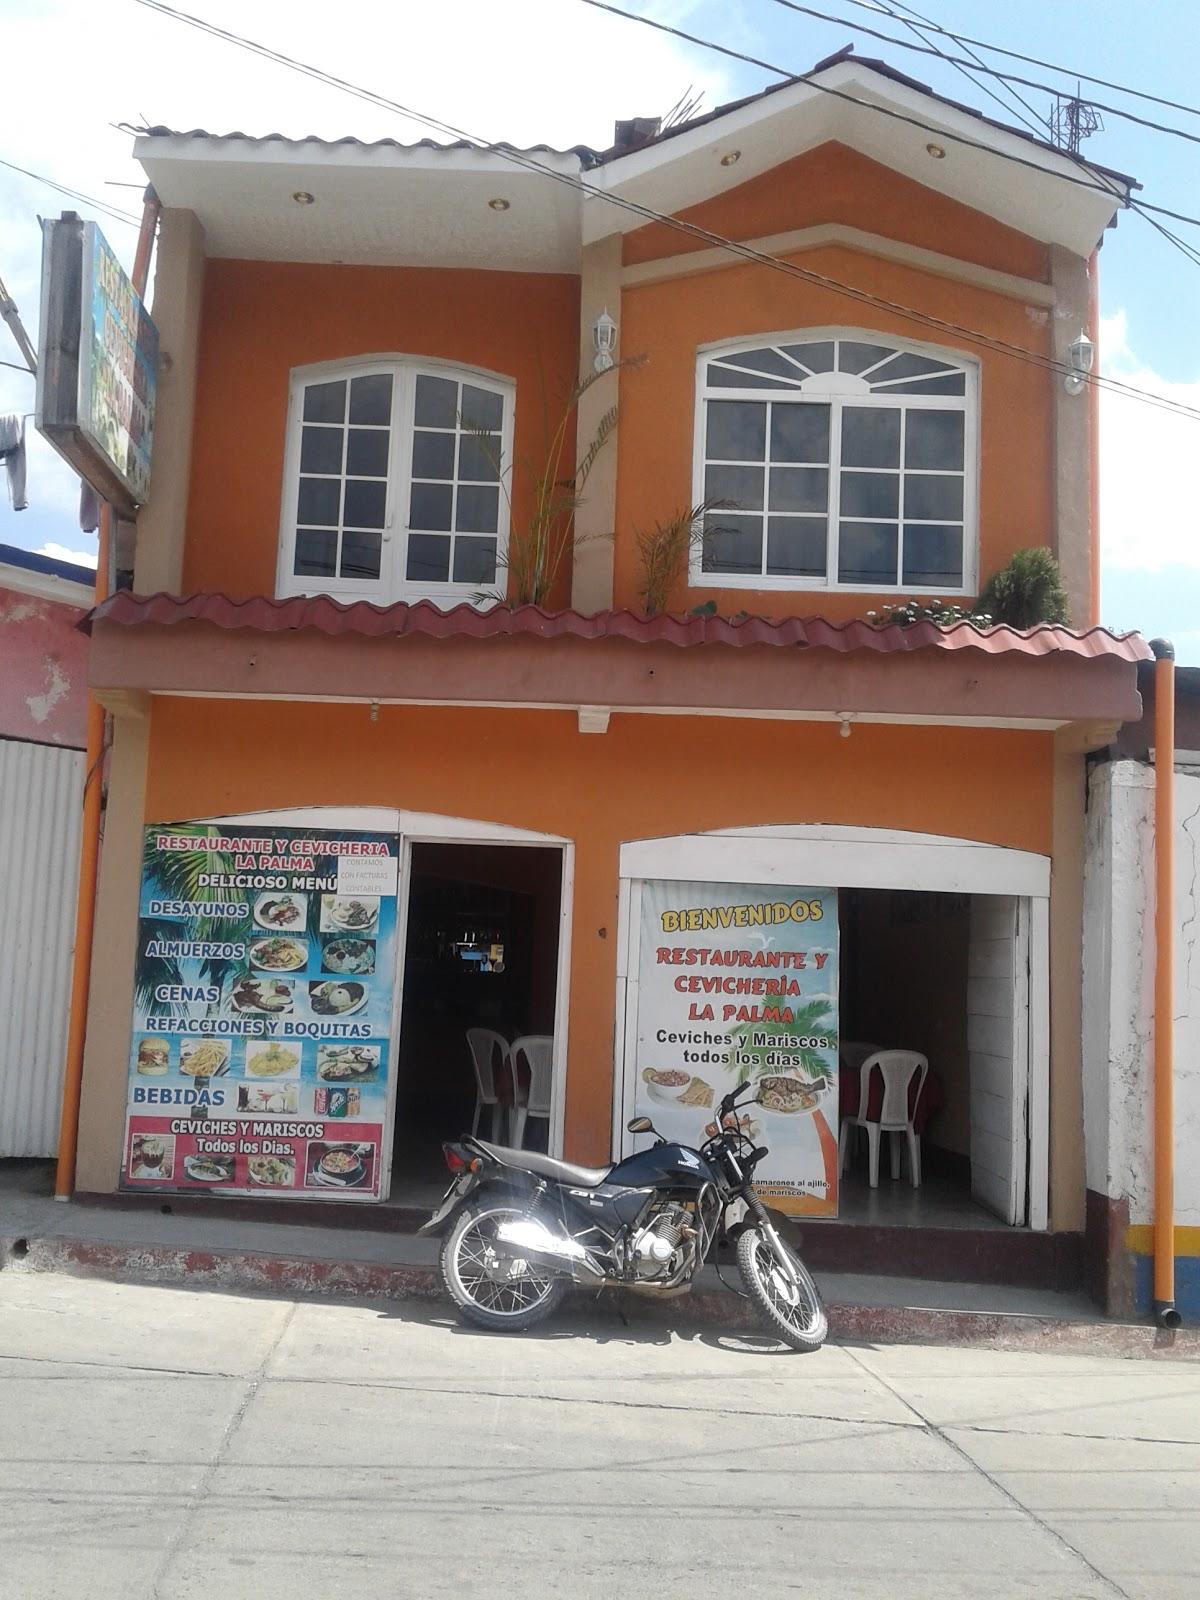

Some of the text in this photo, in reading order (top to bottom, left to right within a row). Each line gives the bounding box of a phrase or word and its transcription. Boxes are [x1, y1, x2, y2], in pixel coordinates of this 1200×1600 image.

[157, 836, 389, 856] RESTAURANTE Y CEVICHERIA
[234, 855, 315, 871] LA PALMA
[198, 873, 338, 890] DELICIOSO MENÚ
[341, 871, 388, 880] CON FACTURAS
[150, 900, 248, 917] DESAYUNOS
[661, 900, 823, 932] BIENVENIDOS
[145, 941, 245, 959] ALMUERZOS
[656, 947, 828, 969] RESTAURANTE Y
[156, 984, 220, 1001] CENAS
[688, 1003, 795, 1023] LA PALMA
[146, 1018, 372, 1038] REFACCIONES Y BOQUITAS
[656, 1029, 828, 1048] Ceviches y Mariscos
[683, 1050, 729, 1064] todos
[736, 1051, 760, 1065] los
[133, 1087, 225, 1106] BEBIDAS
[170, 1119, 324, 1138] CEVICHES Y MARISCOS
[196, 1138, 236, 1153] Todos
[239, 1139, 258, 1153] los
